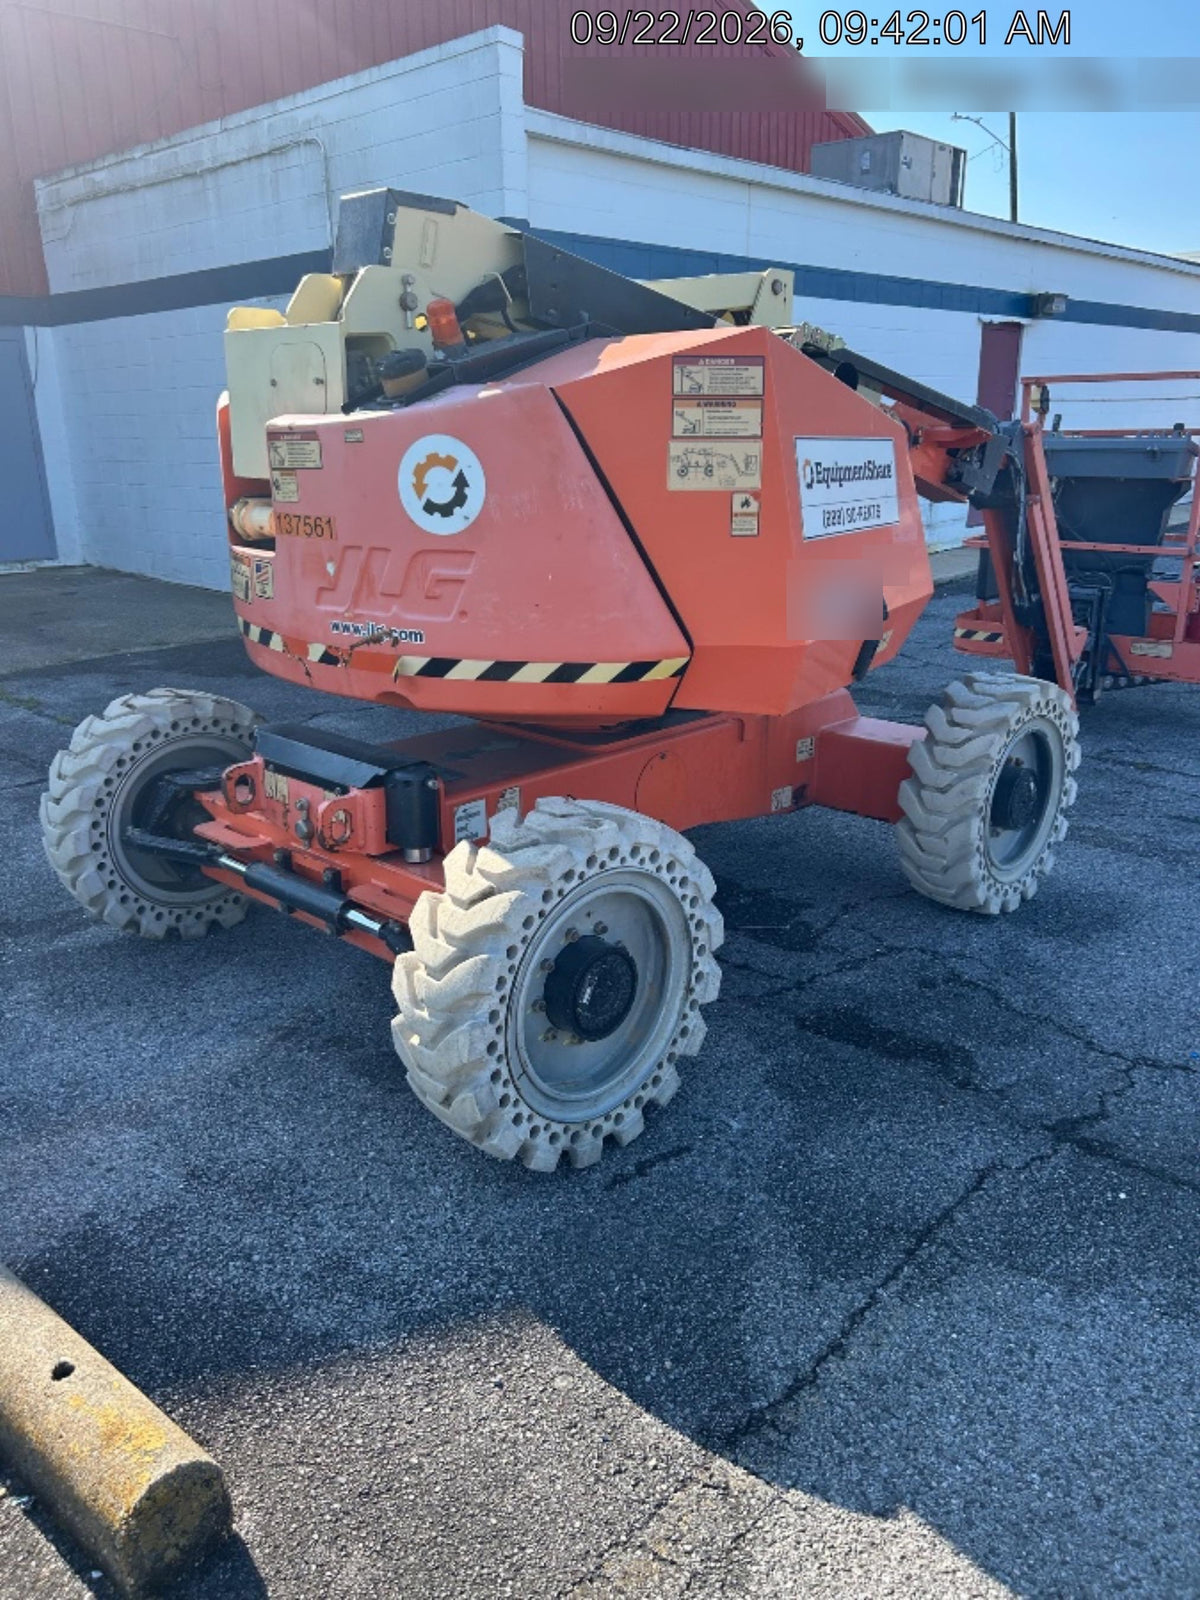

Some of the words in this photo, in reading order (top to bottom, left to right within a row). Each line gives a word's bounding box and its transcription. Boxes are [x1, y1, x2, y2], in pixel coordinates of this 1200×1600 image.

[814, 460, 892, 488] EquipmentShare
[276, 512, 334, 539] 137561
[315, 545, 477, 622] JLG
